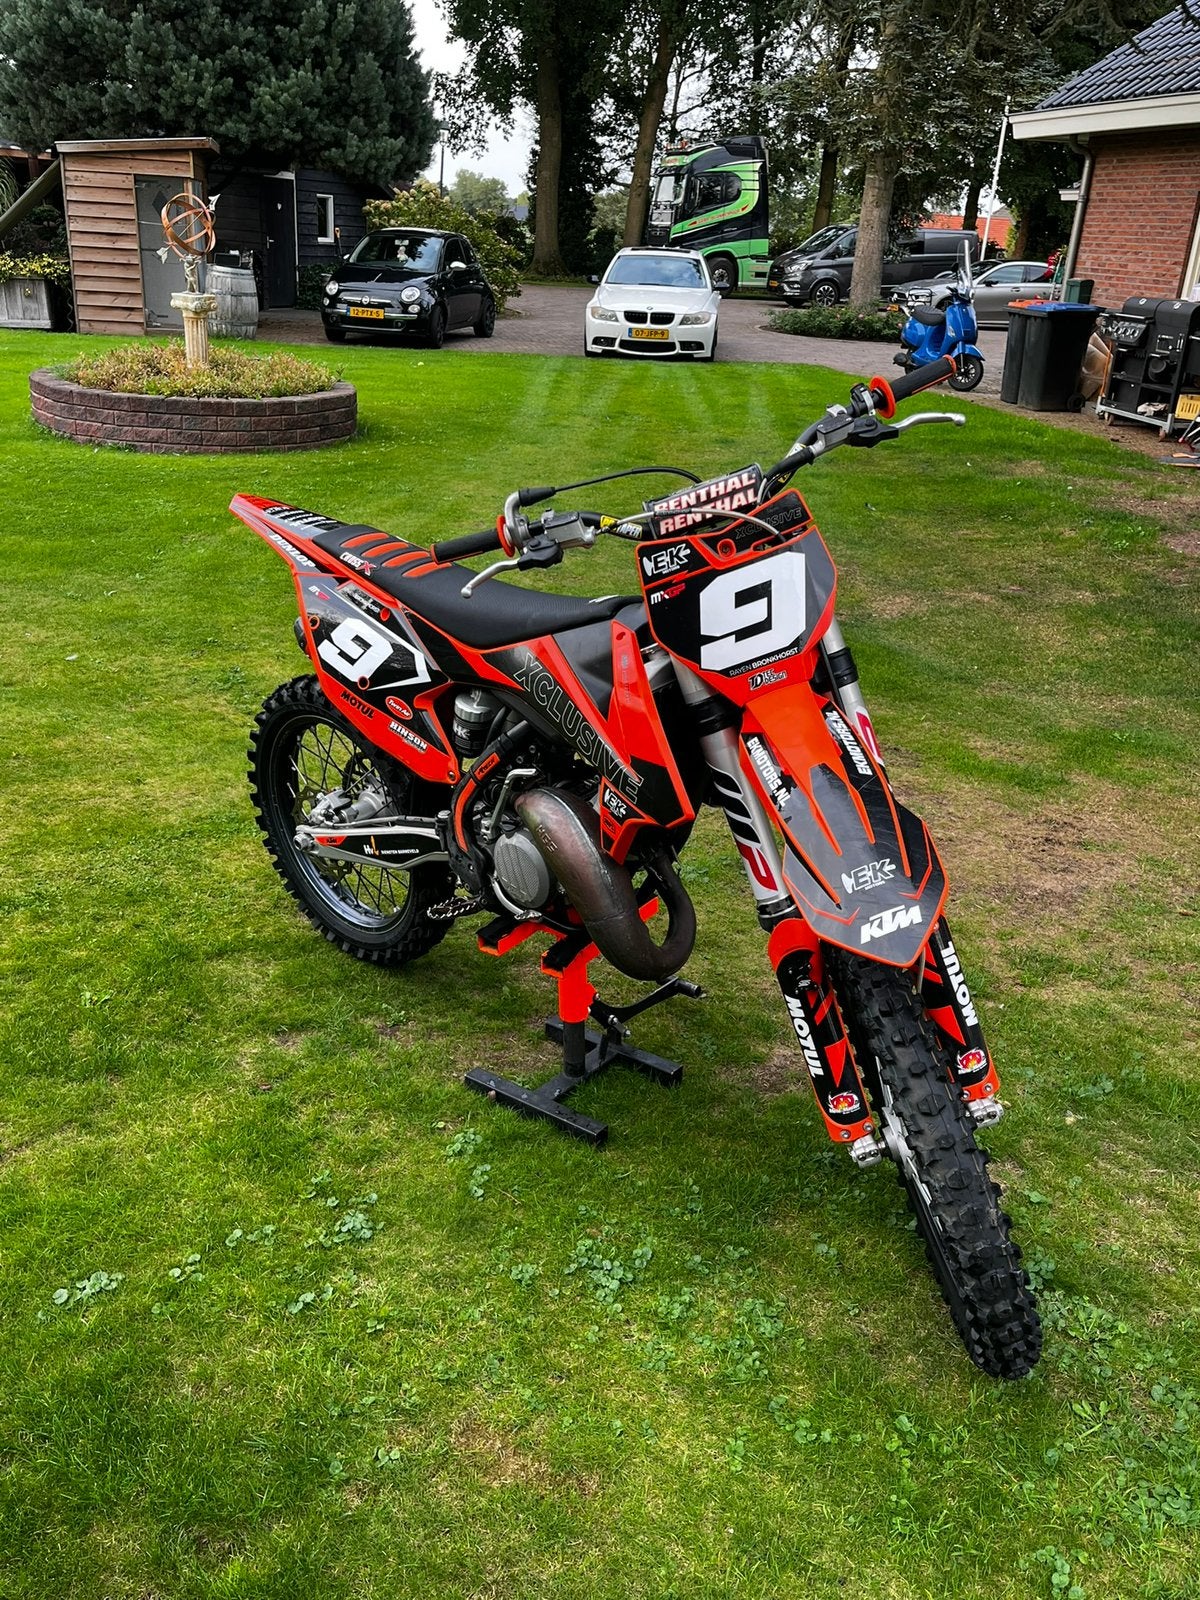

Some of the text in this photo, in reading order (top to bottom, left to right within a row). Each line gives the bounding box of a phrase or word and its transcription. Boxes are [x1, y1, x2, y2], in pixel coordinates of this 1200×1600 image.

[352, 308, 380, 317] 12-PTX-5
[635, 329, 665, 337] 07-JFP-9
[661, 488, 758, 536] RENTHAL
[268, 533, 316, 568] DUNLOP
[700, 550, 806, 671] 9
[317, 617, 394, 682] 9
[729, 647, 799, 677] RAYEN BRONKHORST
[341, 690, 375, 719] MOTUL
[389, 720, 428, 750] HINSON
[513, 652, 645, 804] XCLUSIVE
[747, 736, 791, 807] EKMOTORS.NL
[860, 905, 922, 944] KTM
[940, 941, 978, 1027] MOTUL
[785, 994, 824, 1078] MOTUL
